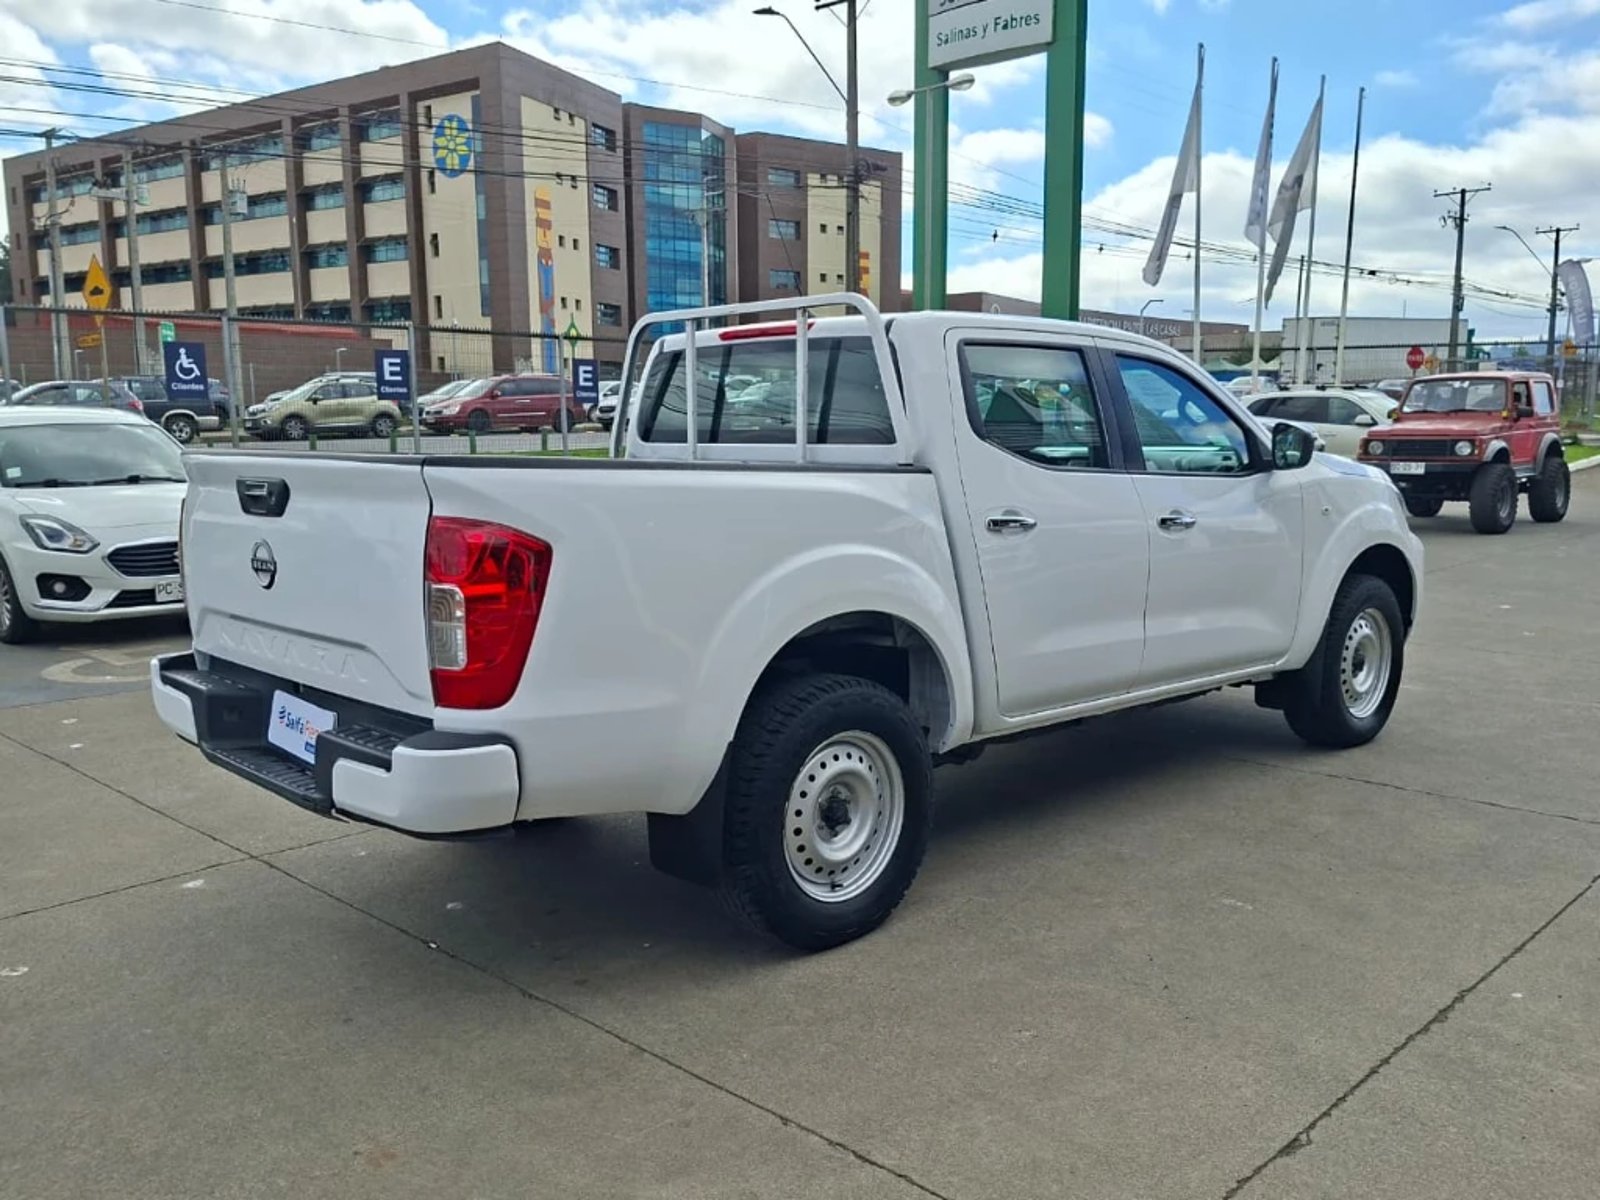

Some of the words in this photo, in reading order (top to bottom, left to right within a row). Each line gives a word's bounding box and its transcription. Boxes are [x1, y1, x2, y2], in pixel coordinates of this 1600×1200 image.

[936, 26, 978, 47] Salinas
[981, 23, 989, 39] y
[993, 12, 1041, 33] Fabres
[383, 357, 402, 380] E
[578, 365, 594, 387] E
[171, 382, 205, 391] Clientes
